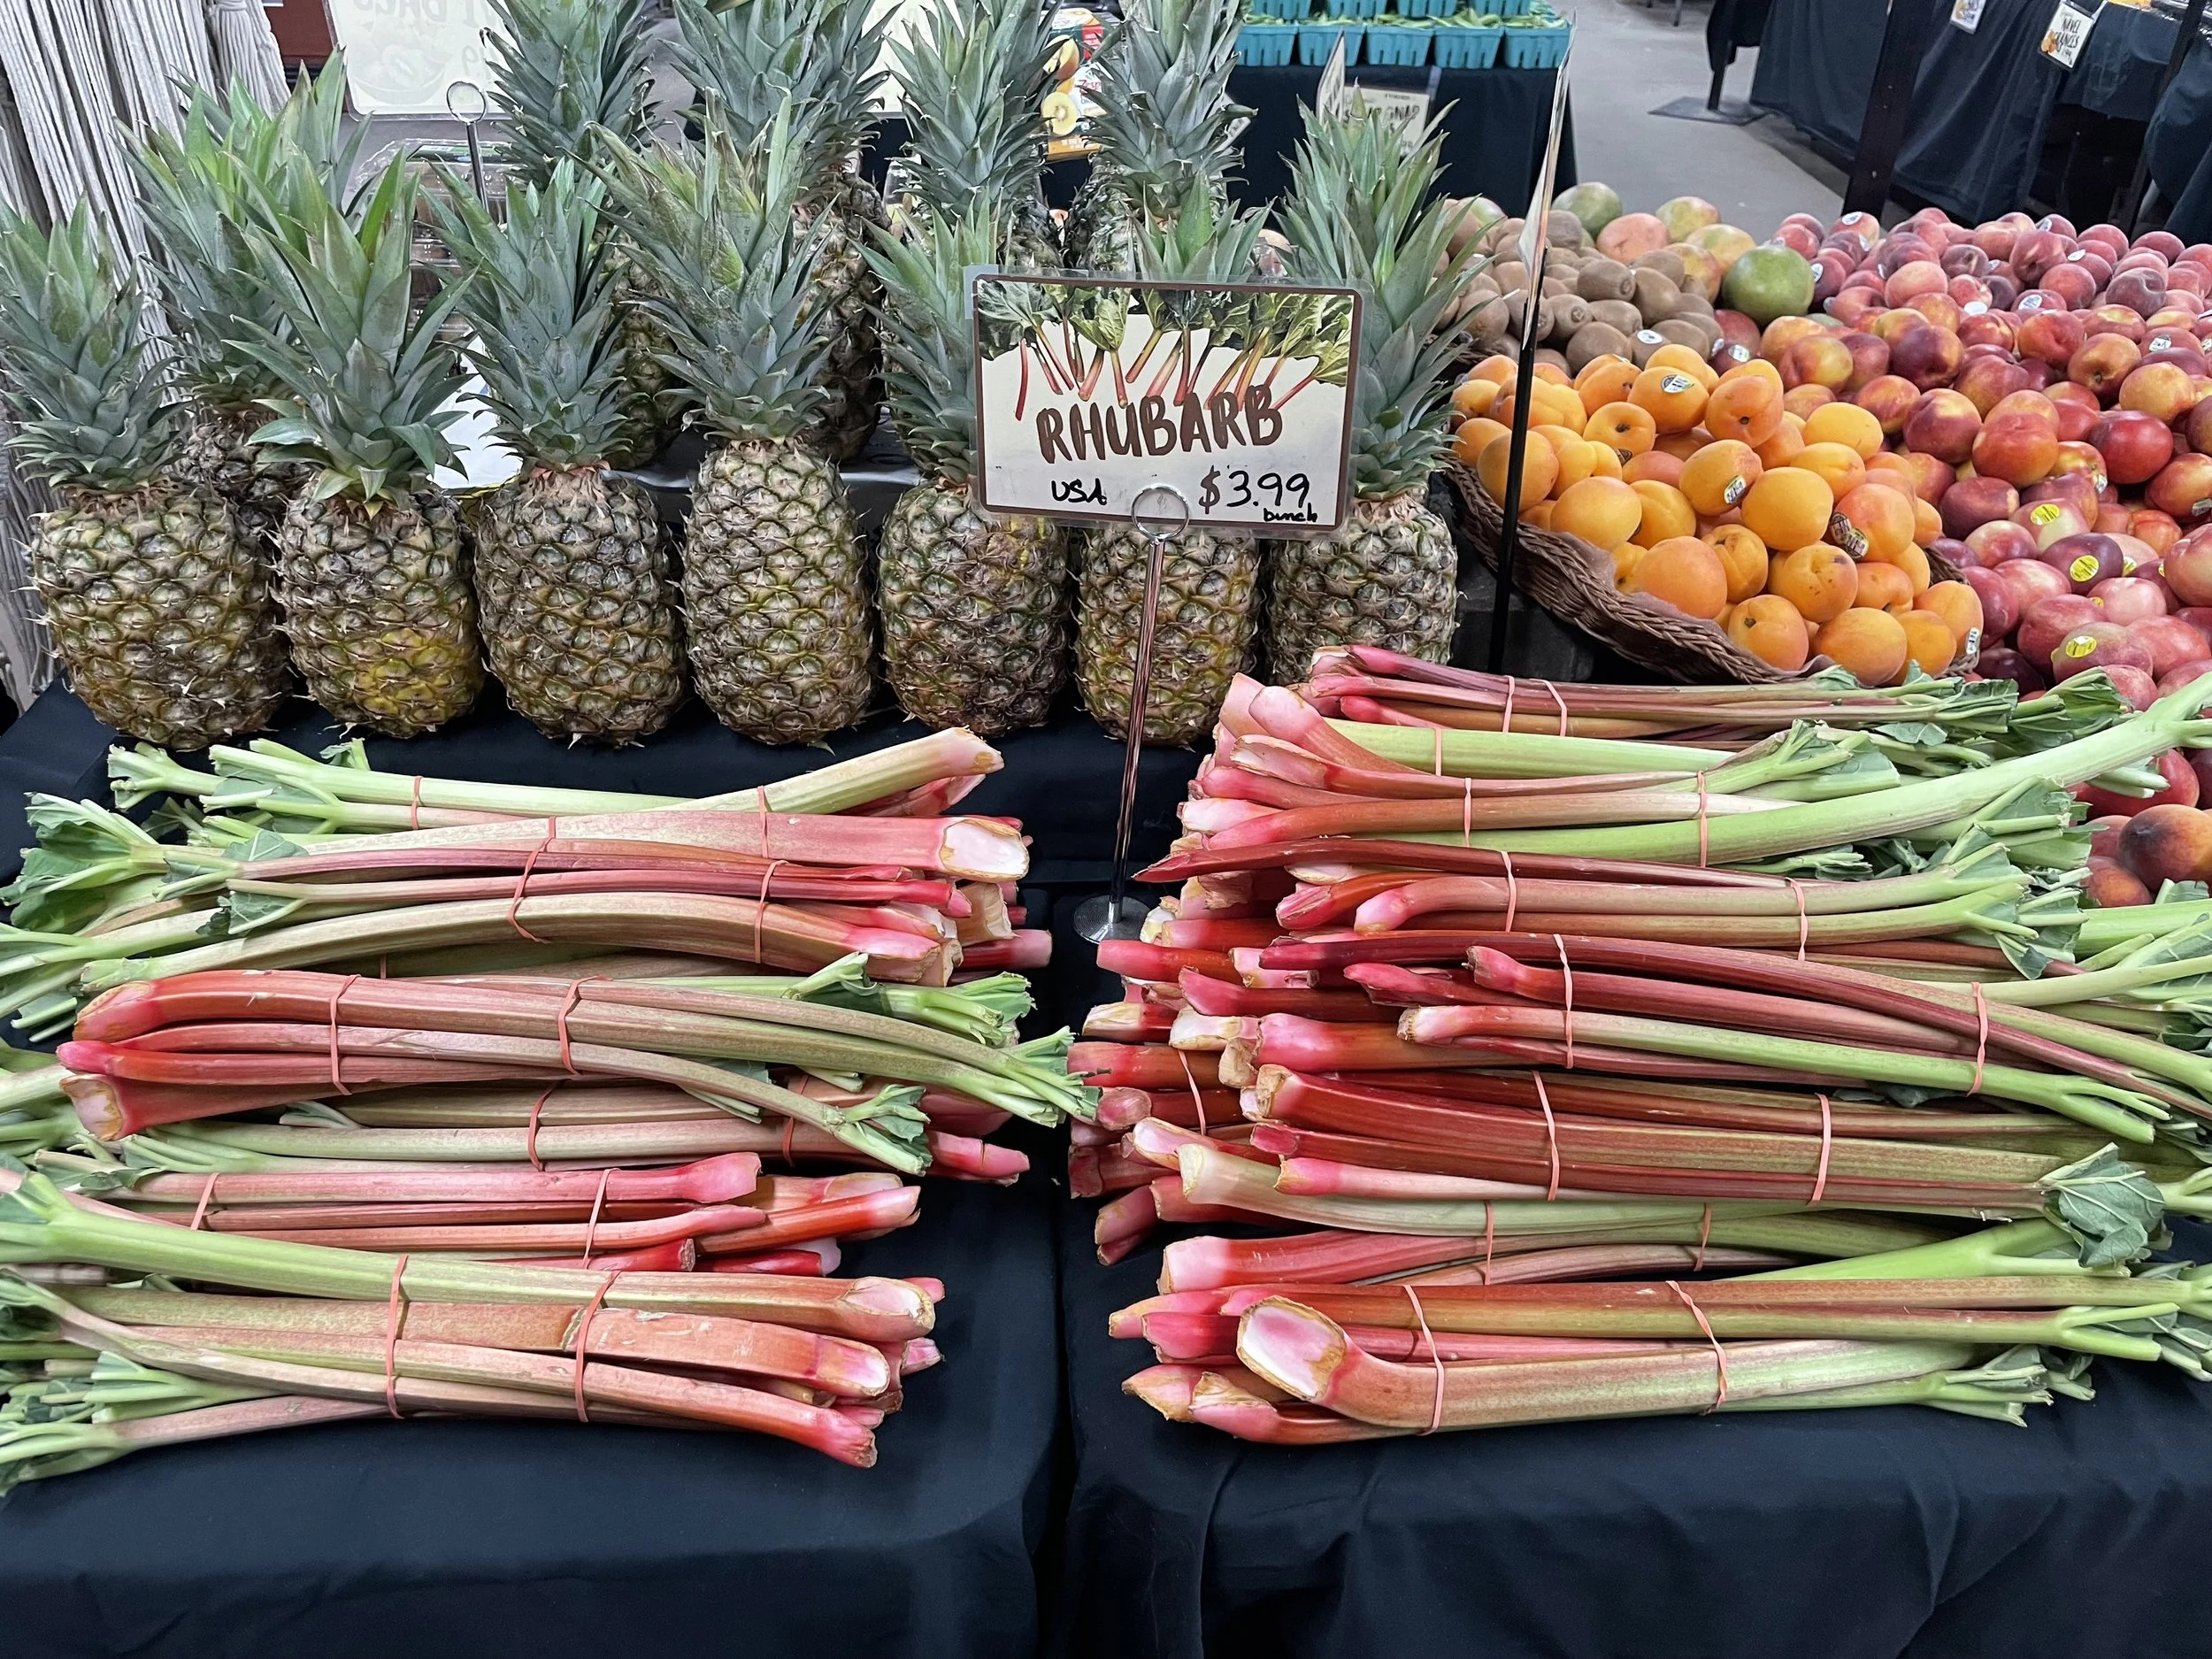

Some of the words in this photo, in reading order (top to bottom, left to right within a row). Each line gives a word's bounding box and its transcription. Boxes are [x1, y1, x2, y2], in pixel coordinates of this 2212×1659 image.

[1036, 385, 1282, 464] RHUBARB
[1051, 479, 1107, 505] USA
[1199, 466, 1311, 514] $3.99
[1263, 503, 1317, 524] bunch
